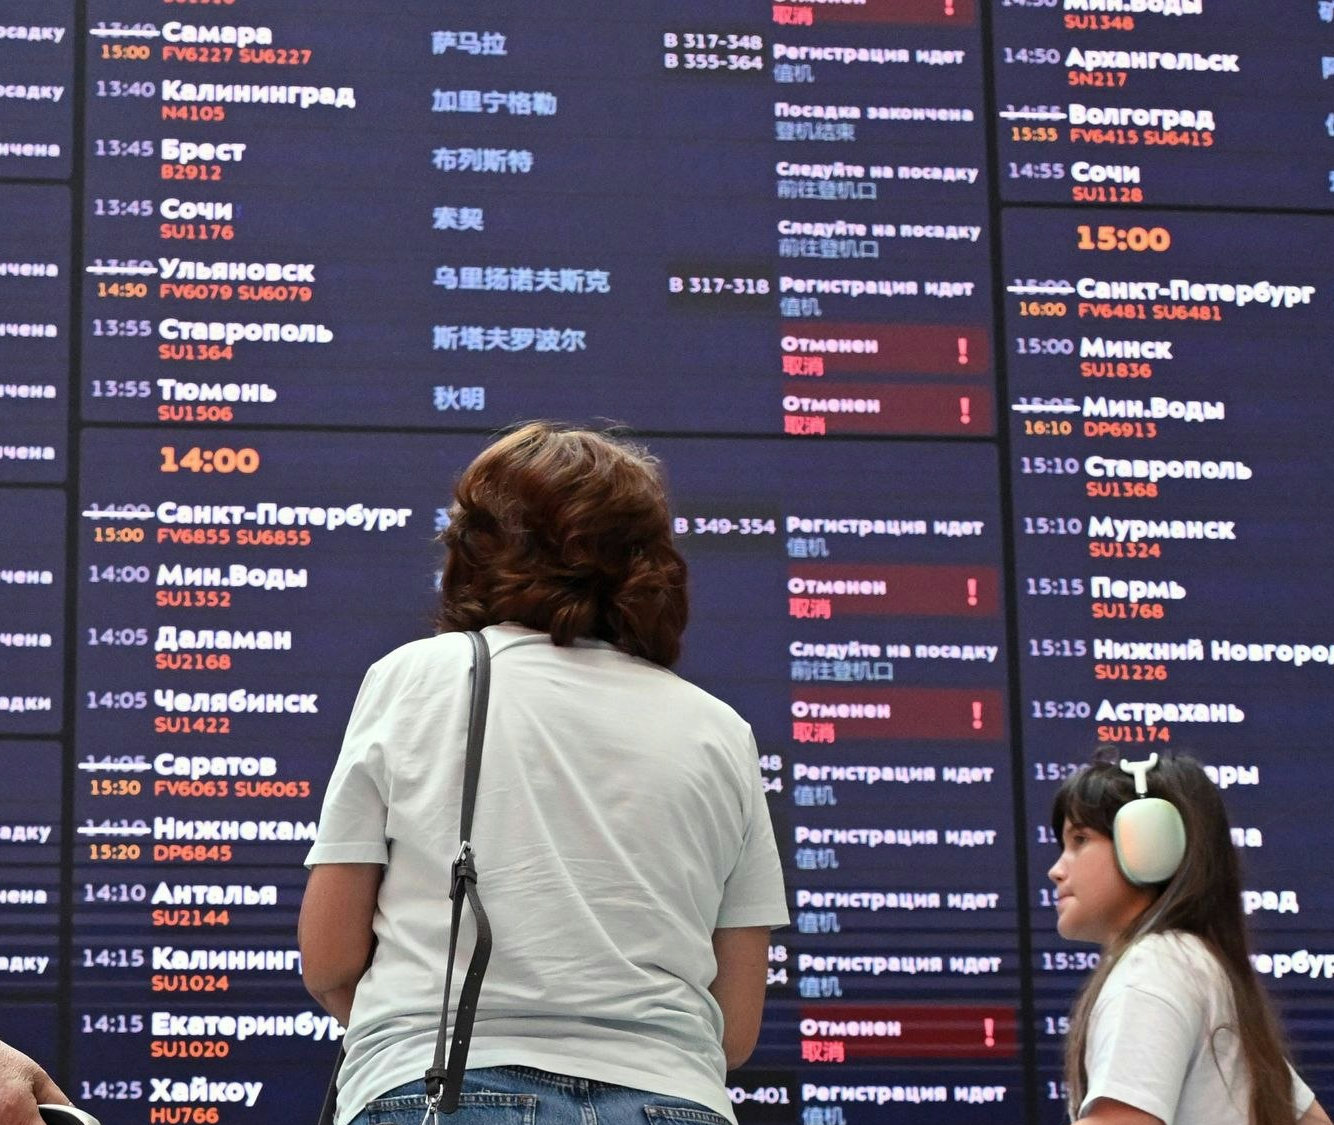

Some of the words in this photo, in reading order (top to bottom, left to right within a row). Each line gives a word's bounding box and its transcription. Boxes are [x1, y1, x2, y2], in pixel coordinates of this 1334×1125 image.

[162, 22, 272, 47] Самара
[431, 31, 507, 55] 萨马拉
[1004, 48, 1060, 64] 14:50
[1065, 47, 1239, 72] Архангельск
[97, 81, 155, 97] 13:40
[162, 80, 356, 108] Калининград
[432, 89, 557, 115] 加里宁格勒
[162, 106, 224, 121] N4105
[1069, 104, 1215, 131] Волгоград
[1071, 128, 1138, 144] FV6415
[1144, 131, 1213, 146] SU6415
[96, 139, 153, 156] 13:45
[162, 139, 246, 164] Брест
[433, 147, 533, 173] 布列斯特
[776, 162, 866, 183] Следуйте
[872, 166, 894, 179] на
[898, 167, 978, 183] посадку
[1071, 161, 1140, 183] Сочи
[160, 198, 232, 220] Сочи
[160, 224, 234, 240] SU1176
[1078, 226, 1170, 251] 15:00
[158, 258, 315, 282] Ульяновск
[1076, 278, 1315, 308] Санкт-Петербург
[159, 318, 333, 345] Ставрополь
[781, 336, 878, 353] Отменен
[1080, 337, 1173, 359] Минск
[1081, 362, 1152, 378] SU1836
[157, 379, 277, 402] Тюмень
[434, 386, 484, 410] 秋明
[1082, 396, 1224, 422] Мин.Воды
[1084, 422, 1156, 437] DP6913
[161, 447, 259, 473] 14:00
[1085, 456, 1252, 482] Ставрополь
[157, 502, 412, 531] Санкт-Петербург
[674, 518, 688, 533] B
[695, 518, 776, 534] 349-354
[786, 516, 926, 537] Регистрация
[934, 521, 984, 537] идет
[157, 528, 230, 544] FV6855
[236, 529, 311, 545] SU6855
[1025, 517, 1082, 534] 15:10
[1088, 516, 1236, 542] Мурманск
[90, 565, 150, 582] 14:00
[156, 564, 307, 590] Мин.Воды
[1091, 576, 1186, 603] Пермь
[89, 628, 148, 645] 14:05
[155, 626, 291, 651] Даламан
[1094, 639, 1204, 660] Нижний
[156, 653, 231, 669] SU2168
[1095, 664, 1167, 680] SU1226
[154, 689, 318, 713] Челябинск
[1033, 701, 1090, 718] 15:20
[1095, 700, 1244, 726] Астрахань
[154, 753, 277, 780] Саратов
[154, 845, 232, 861] DP6845
[151, 882, 277, 905] Анталья
[152, 975, 229, 991] SU1024
[800, 1019, 901, 1036] Отменен
[802, 1040, 845, 1062] 取消
[82, 1081, 142, 1099] 14:25
[149, 1077, 263, 1107] Хайкоу
[151, 1107, 219, 1124] HU766
